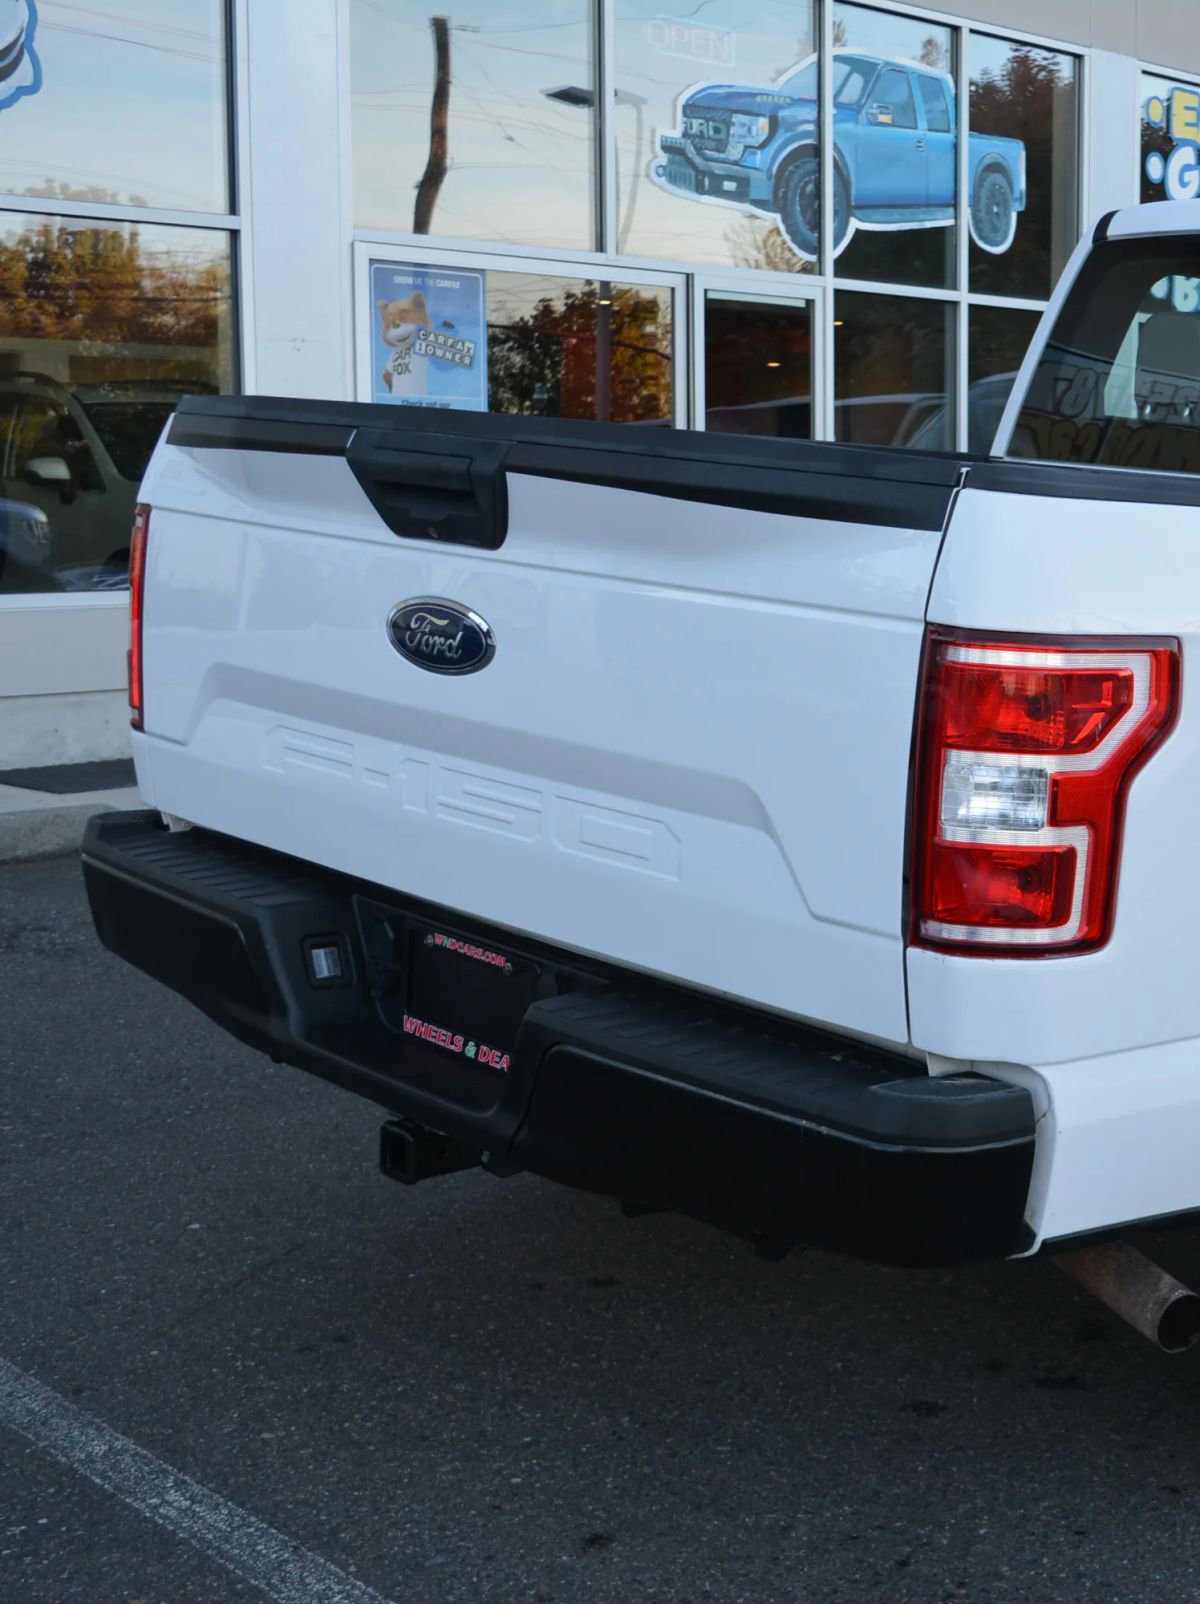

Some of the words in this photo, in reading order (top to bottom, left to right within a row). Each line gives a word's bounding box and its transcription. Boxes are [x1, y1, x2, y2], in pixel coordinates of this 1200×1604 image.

[647, 20, 730, 60] OPEN
[418, 329, 474, 356] CARFAX
[426, 343, 472, 367] OWNER
[393, 362, 411, 376] FOX
[405, 612, 464, 658] Ford
[262, 724, 683, 883] F-150
[403, 1014, 465, 1052] WHEELS
[465, 1040, 477, 1059] &
